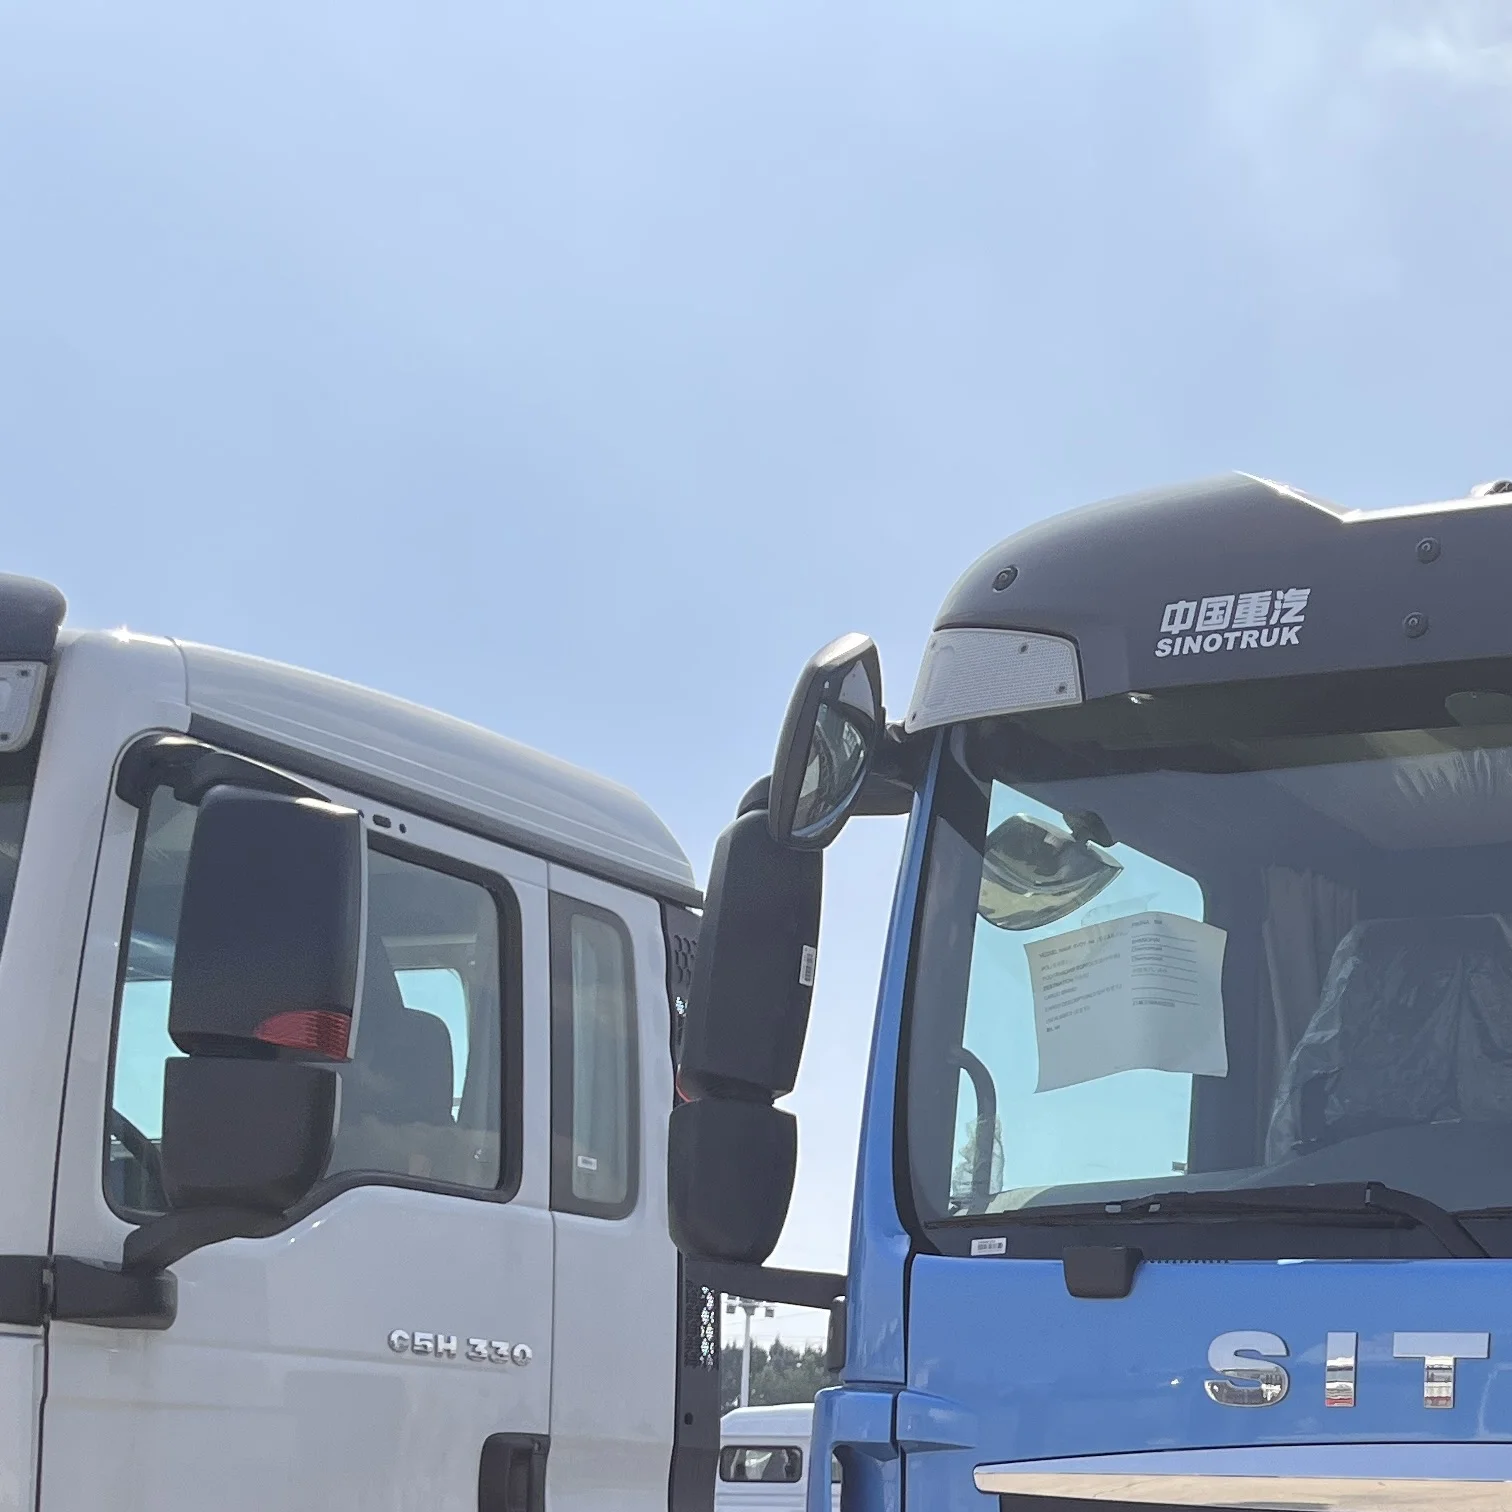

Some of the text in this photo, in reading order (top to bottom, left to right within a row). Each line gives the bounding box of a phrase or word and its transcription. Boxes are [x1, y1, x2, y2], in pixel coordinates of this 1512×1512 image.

[1160, 588, 1311, 635] 中国重汽
[1155, 625, 1302, 657] SINOTRUK
[388, 1329, 533, 1367] C5H 330
